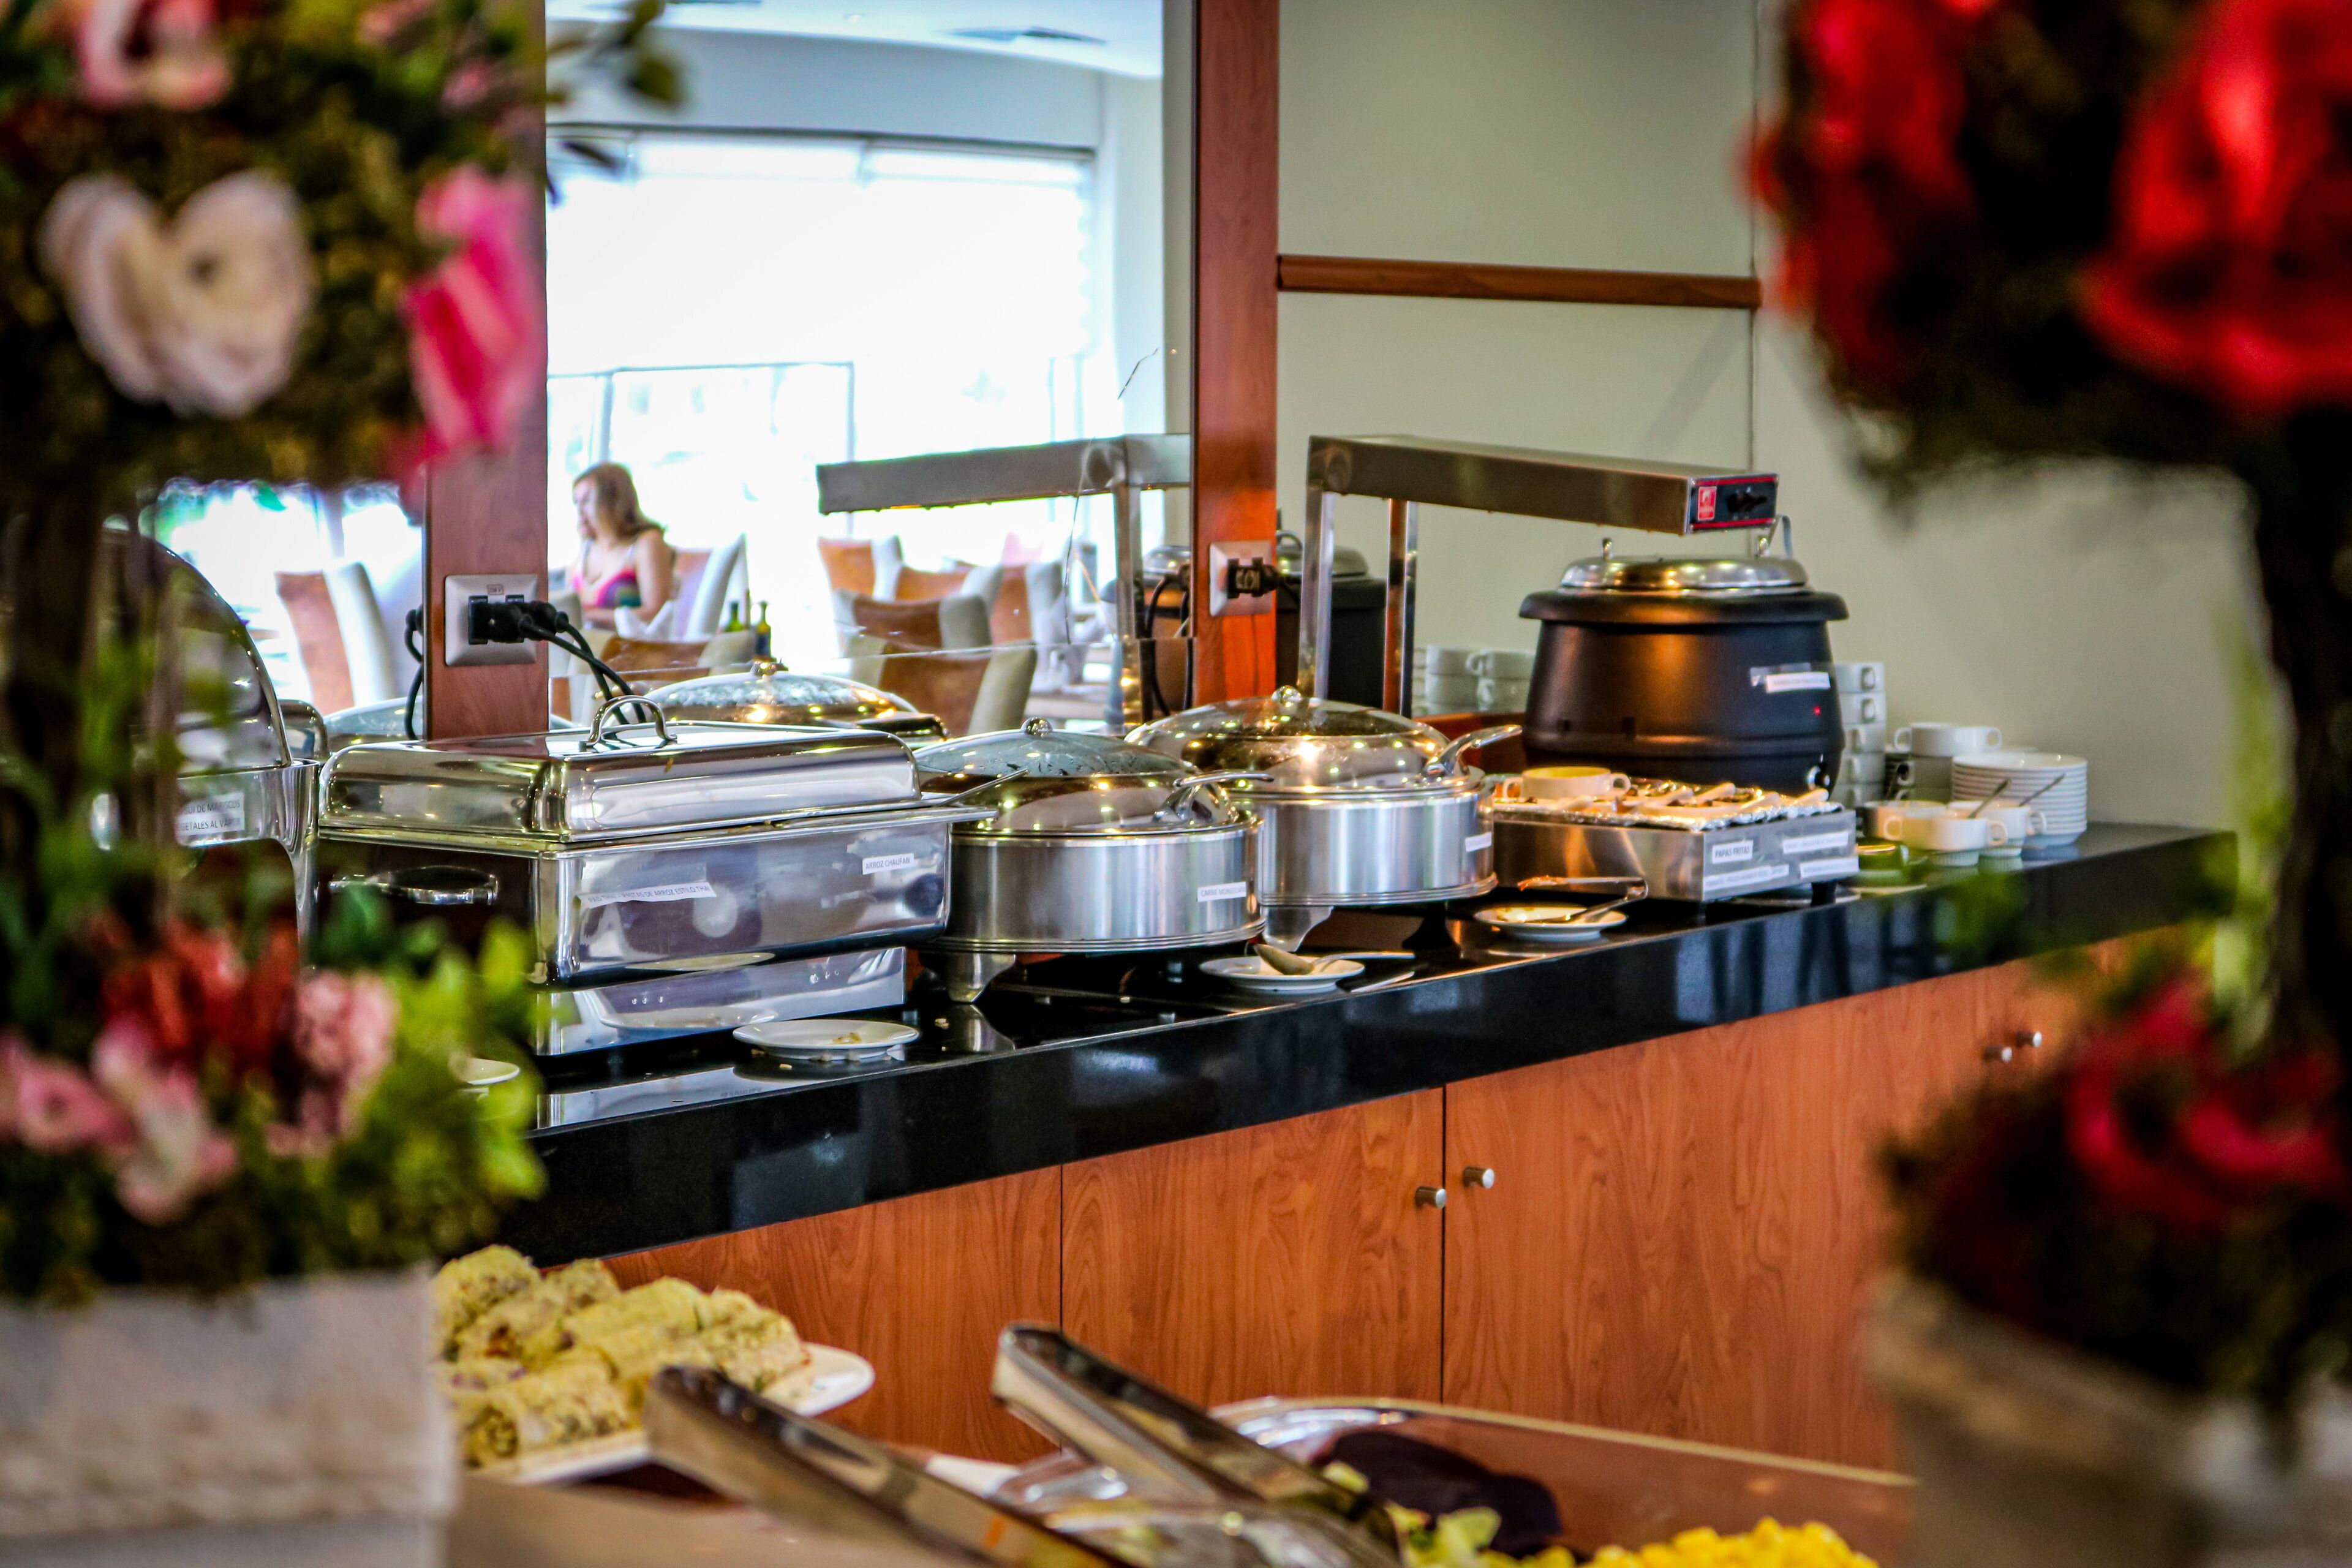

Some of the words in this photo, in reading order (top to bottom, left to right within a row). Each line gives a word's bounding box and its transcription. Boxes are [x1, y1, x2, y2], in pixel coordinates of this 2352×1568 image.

[197, 804, 206, 813] DE
[210, 820, 218, 829] AL
[1715, 848, 1732, 858] PAPAS
[1733, 845, 1751, 855] FRITAS
[865, 861, 883, 869] ARROZ
[884, 857, 910, 867] CHAUFAN
[654, 889, 674, 897] ARROZ
